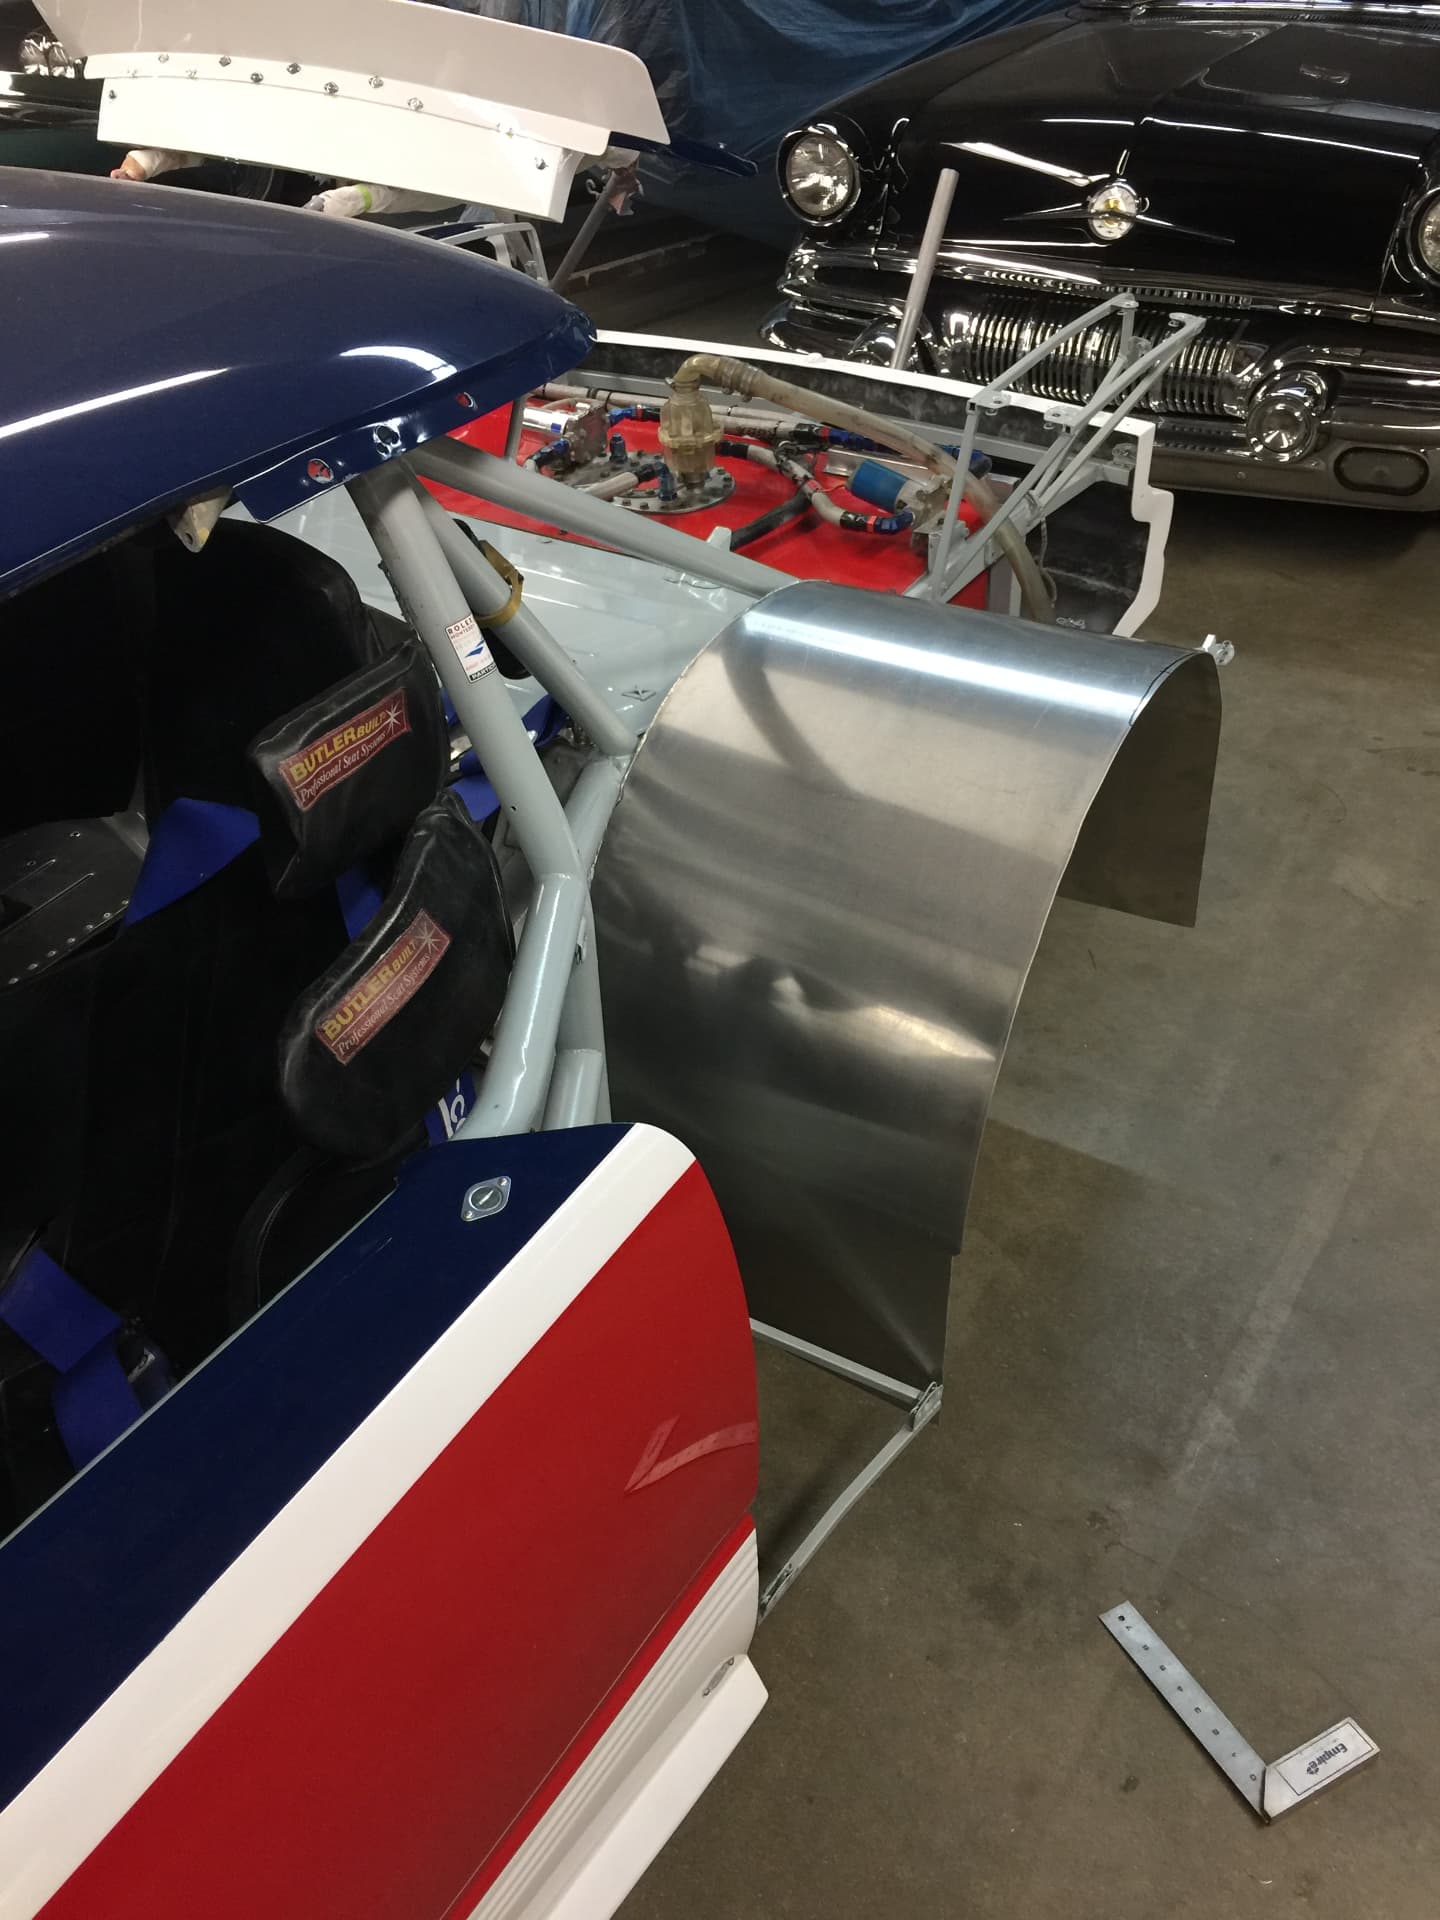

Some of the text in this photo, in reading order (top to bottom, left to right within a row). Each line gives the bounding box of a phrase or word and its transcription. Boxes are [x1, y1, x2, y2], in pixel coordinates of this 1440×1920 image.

[300, 760, 342, 802] Professional
[343, 750, 360, 769] Seat
[336, 953, 431, 1055] Professional Seat Systems
[1308, 1743, 1348, 1769] Empire
